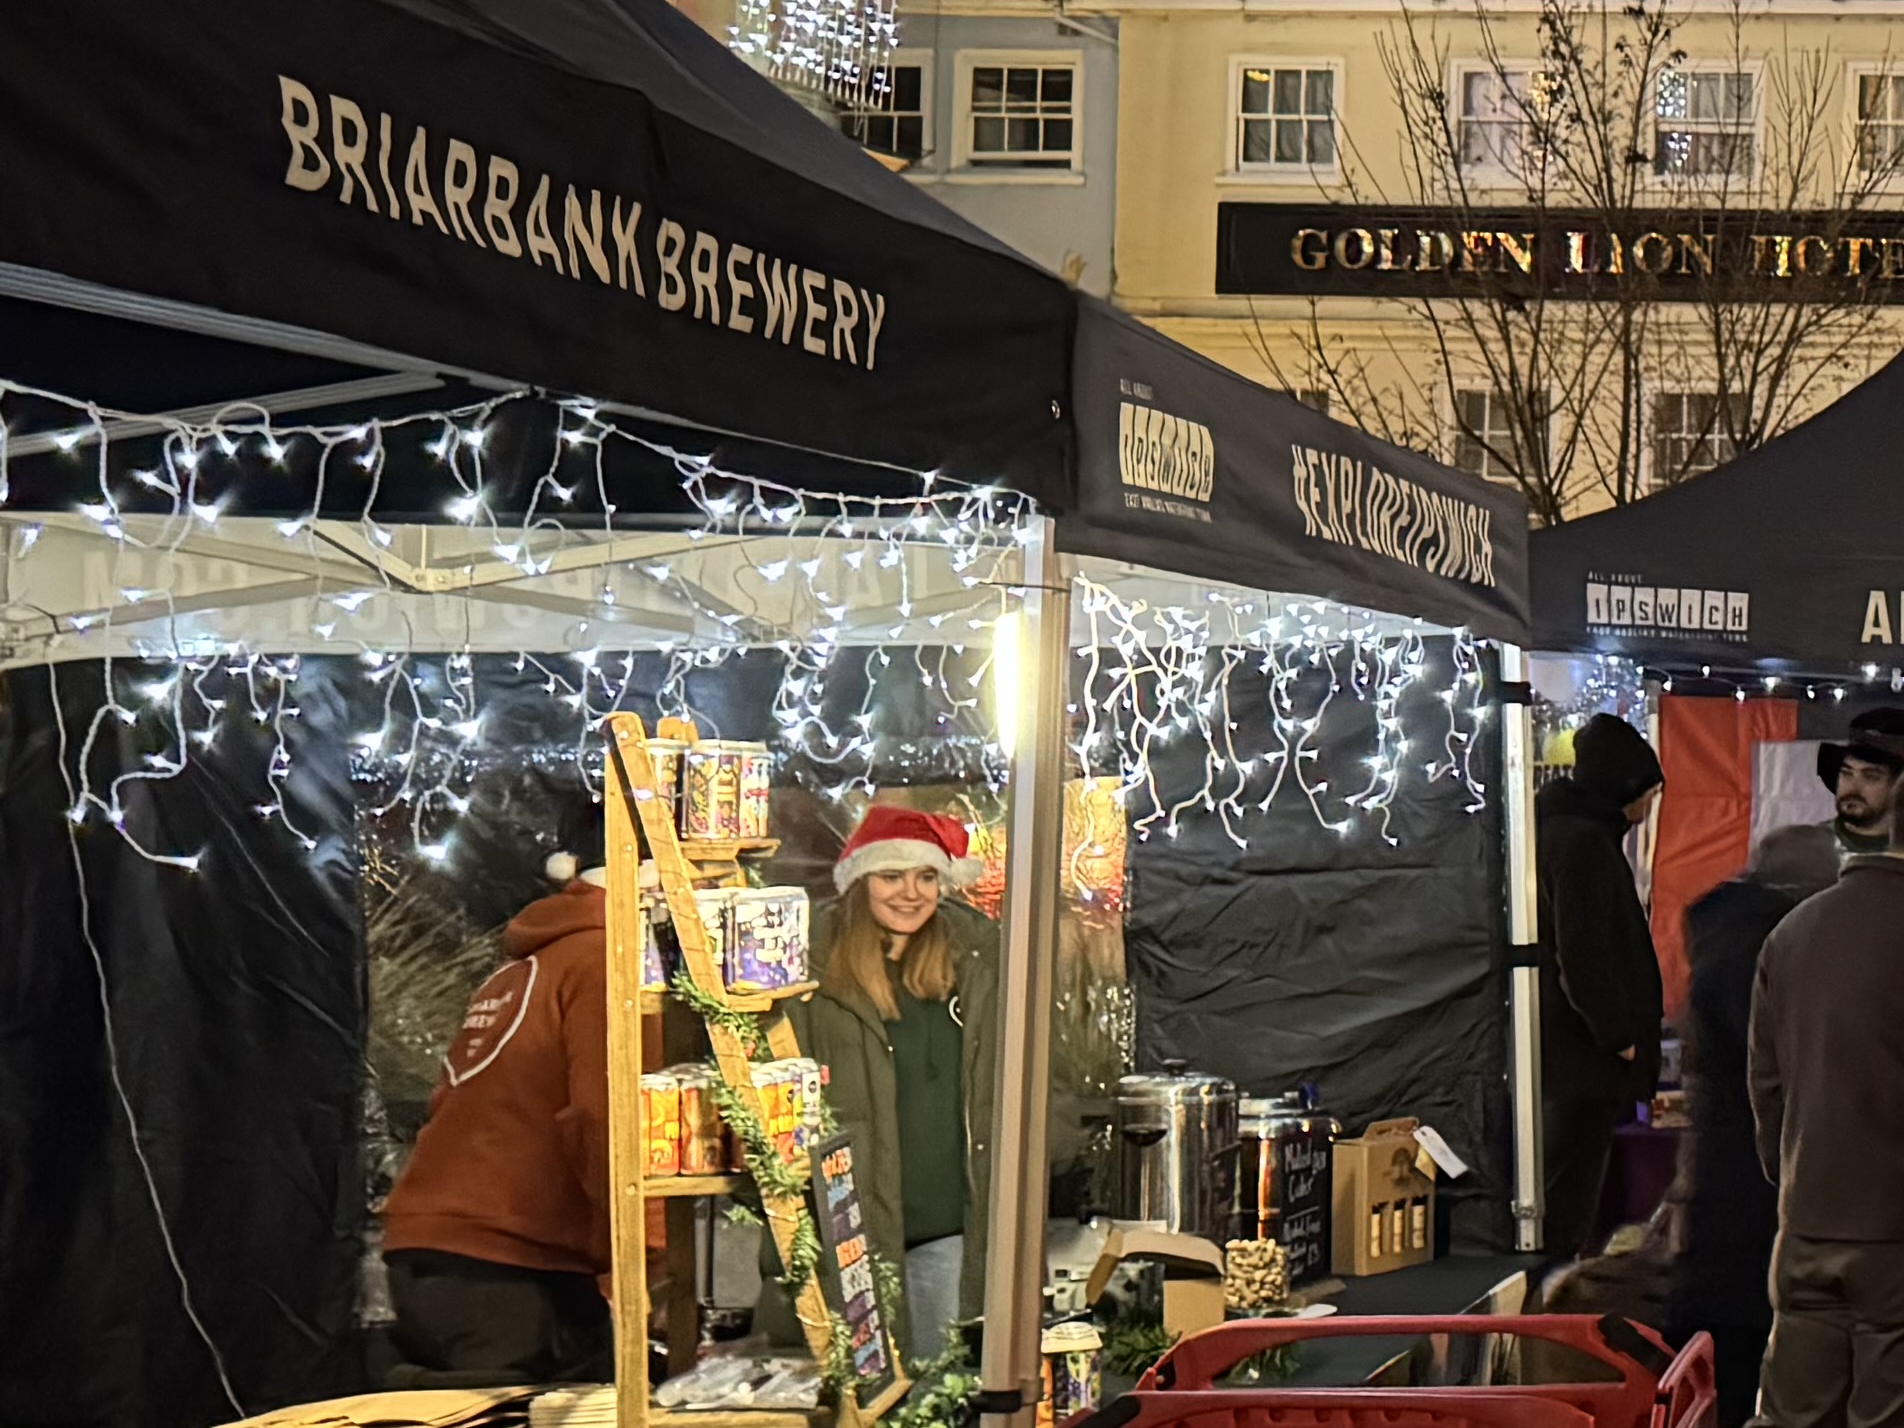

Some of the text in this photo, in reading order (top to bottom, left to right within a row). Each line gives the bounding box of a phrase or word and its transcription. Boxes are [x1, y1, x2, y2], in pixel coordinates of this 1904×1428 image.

[278, 75, 887, 371] BRIARBANK BREWERY
[1290, 227, 1536, 274] GOLDEN
[1564, 231, 1717, 275] LION
[1291, 444, 1496, 587] #EXPLOREIPSWICH
[1591, 594, 1746, 629] IPSWICH
